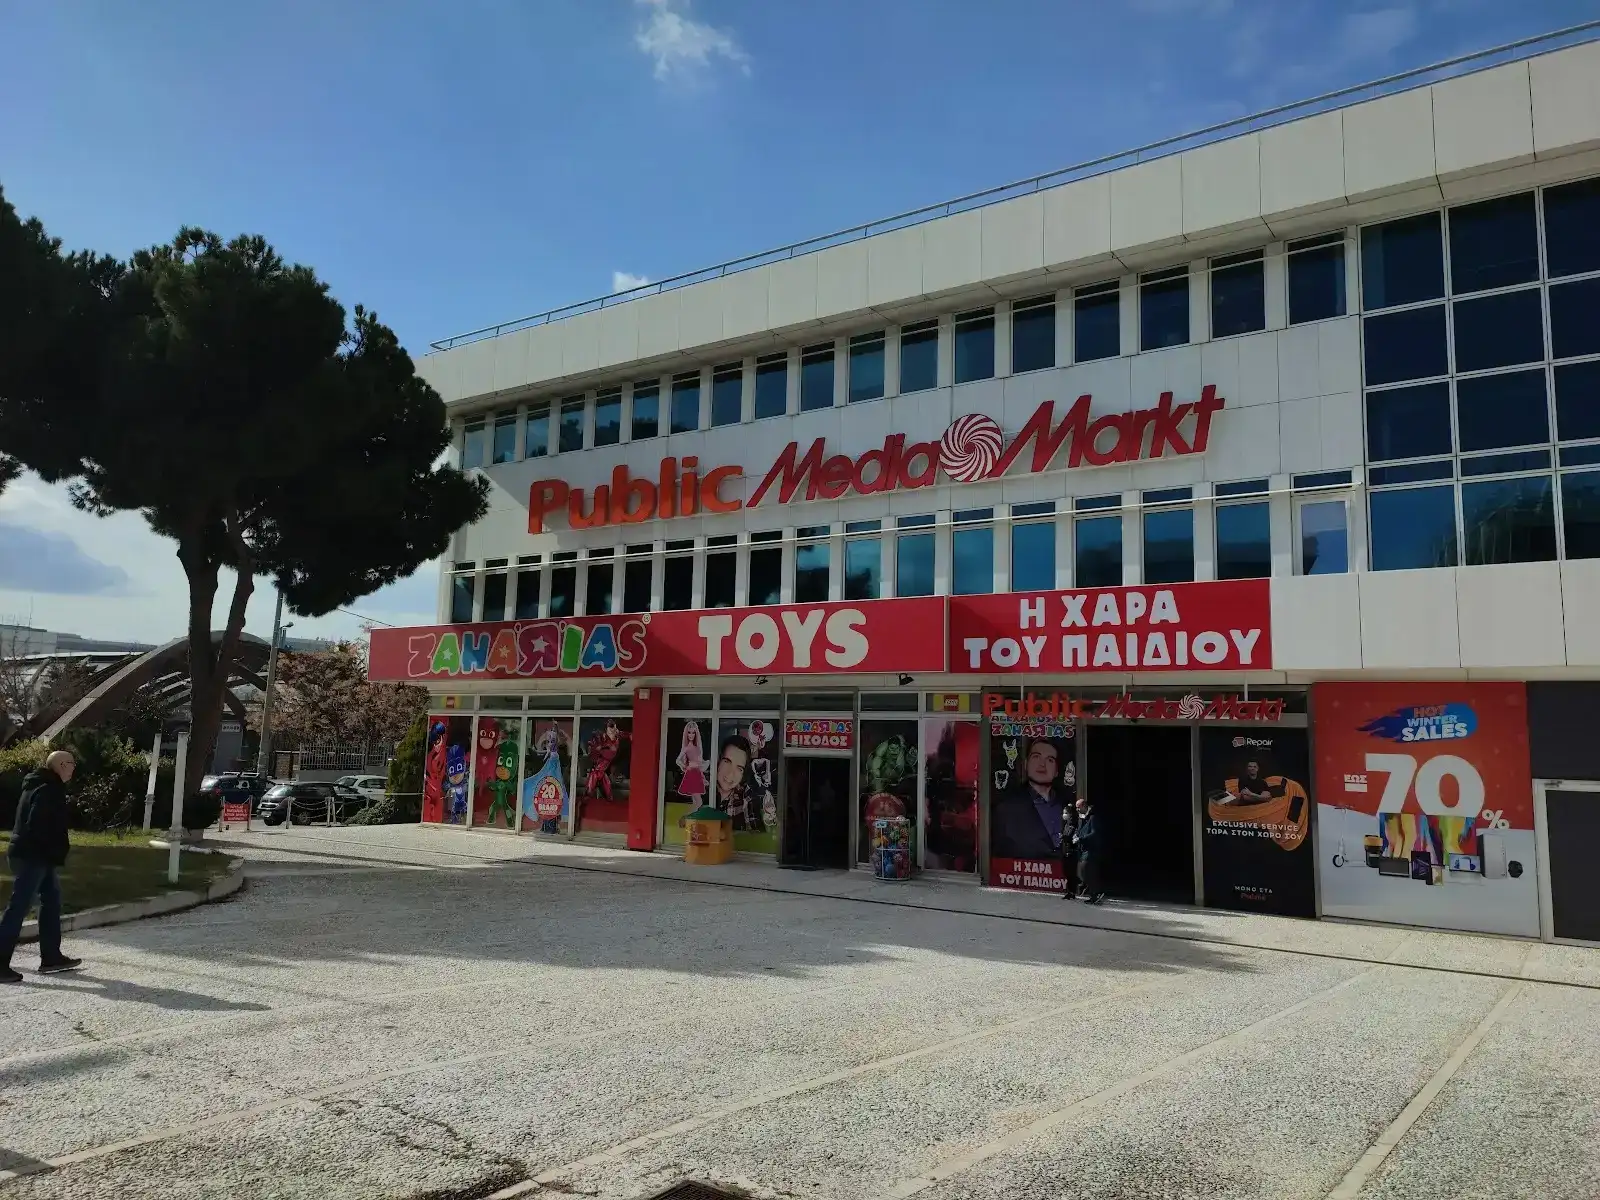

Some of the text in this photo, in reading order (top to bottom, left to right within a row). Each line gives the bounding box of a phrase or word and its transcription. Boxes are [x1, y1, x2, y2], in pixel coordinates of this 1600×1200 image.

[528, 456, 743, 534] Public
[1020, 590, 1180, 629] Η ΧΑΡΑ
[698, 608, 869, 670] TOYS
[964, 628, 1262, 668] ΤΟΥ ΠΑΙΔΙΟΥ
[982, 691, 1093, 718] Public
[1414, 704, 1448, 718] HOT
[1407, 714, 1459, 728] WINTER
[1402, 722, 1468, 742] SALES
[1246, 737, 1273, 747] Repair
[1344, 774, 1368, 783] ΕΩΣ
[1206, 827, 1228, 835] ΤΩΡΑ
[1231, 829, 1254, 837] ΣΤΟΝ
[1257, 831, 1281, 839] ΧΩΡΟ
[1212, 820, 1299, 832] EXCLUSIVE SERVICE
[1013, 861, 1052, 874] Η ΧΑΡΑ
[999, 873, 1068, 889] ΤΟΥ ΠΑΙΔΙΟΥ
